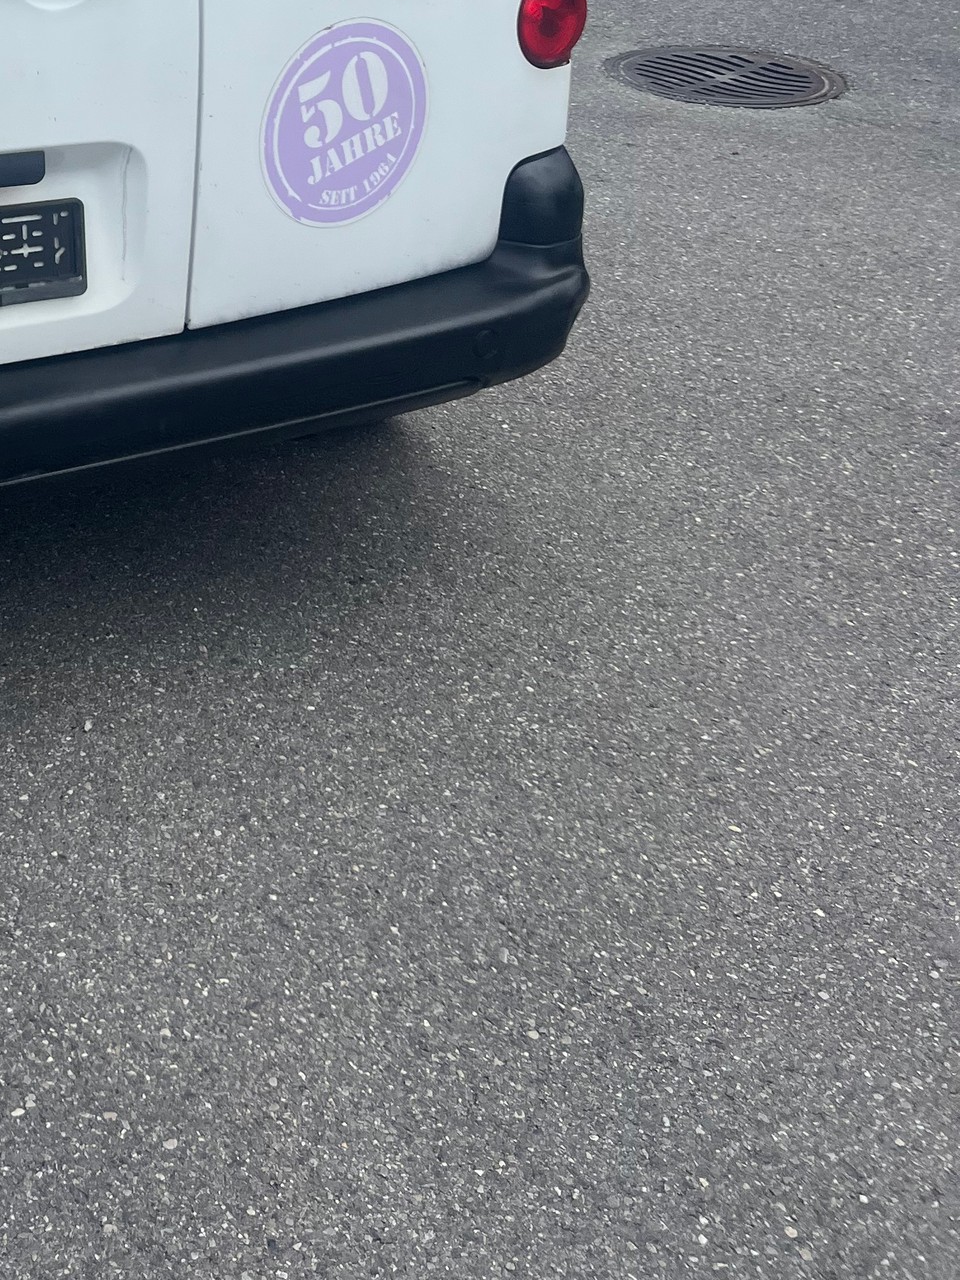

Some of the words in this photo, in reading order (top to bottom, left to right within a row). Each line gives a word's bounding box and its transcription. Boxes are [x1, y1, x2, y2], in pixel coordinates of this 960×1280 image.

[298, 51, 388, 148] 50
[307, 112, 402, 185] JAHRE
[319, 185, 358, 205] SEIT
